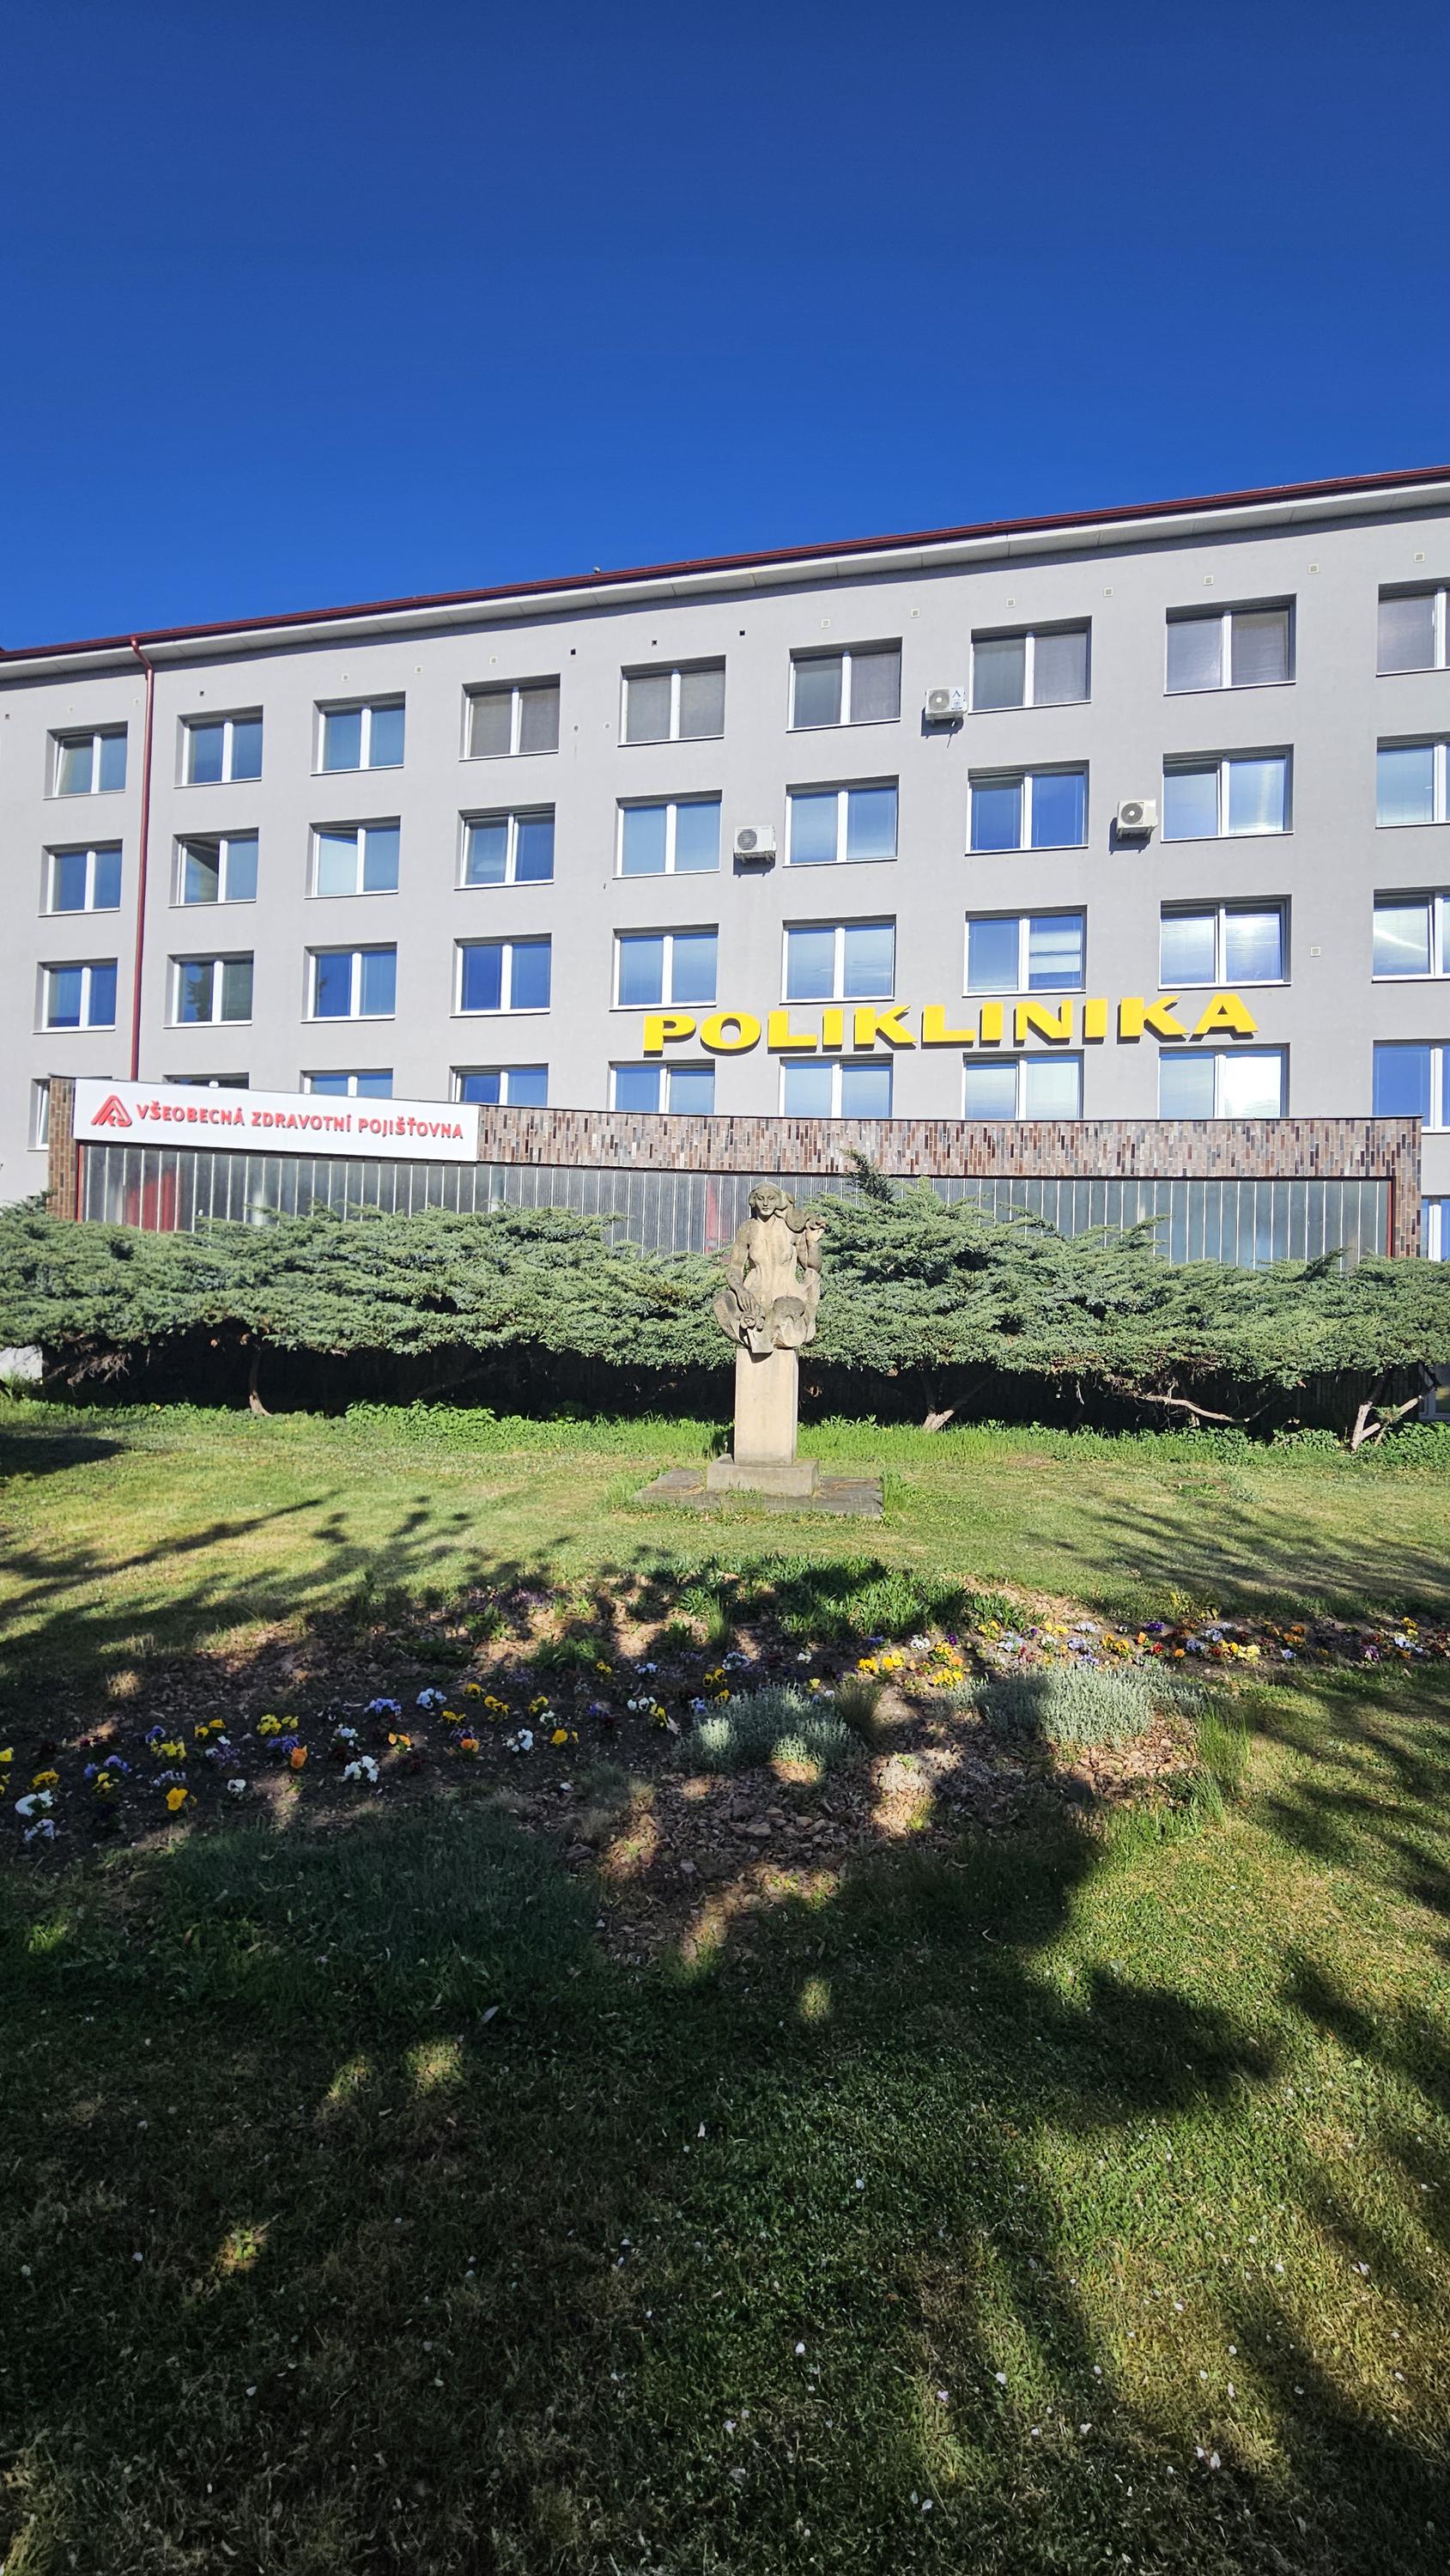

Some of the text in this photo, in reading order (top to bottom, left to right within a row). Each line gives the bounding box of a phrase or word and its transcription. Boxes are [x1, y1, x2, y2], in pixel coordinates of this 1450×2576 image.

[643, 993, 1259, 1052] POLIKLINIKA
[136, 1101, 464, 1139] VŠEOBECNÁ ZDRAVOTNÍ POJIŠŤOVNA
